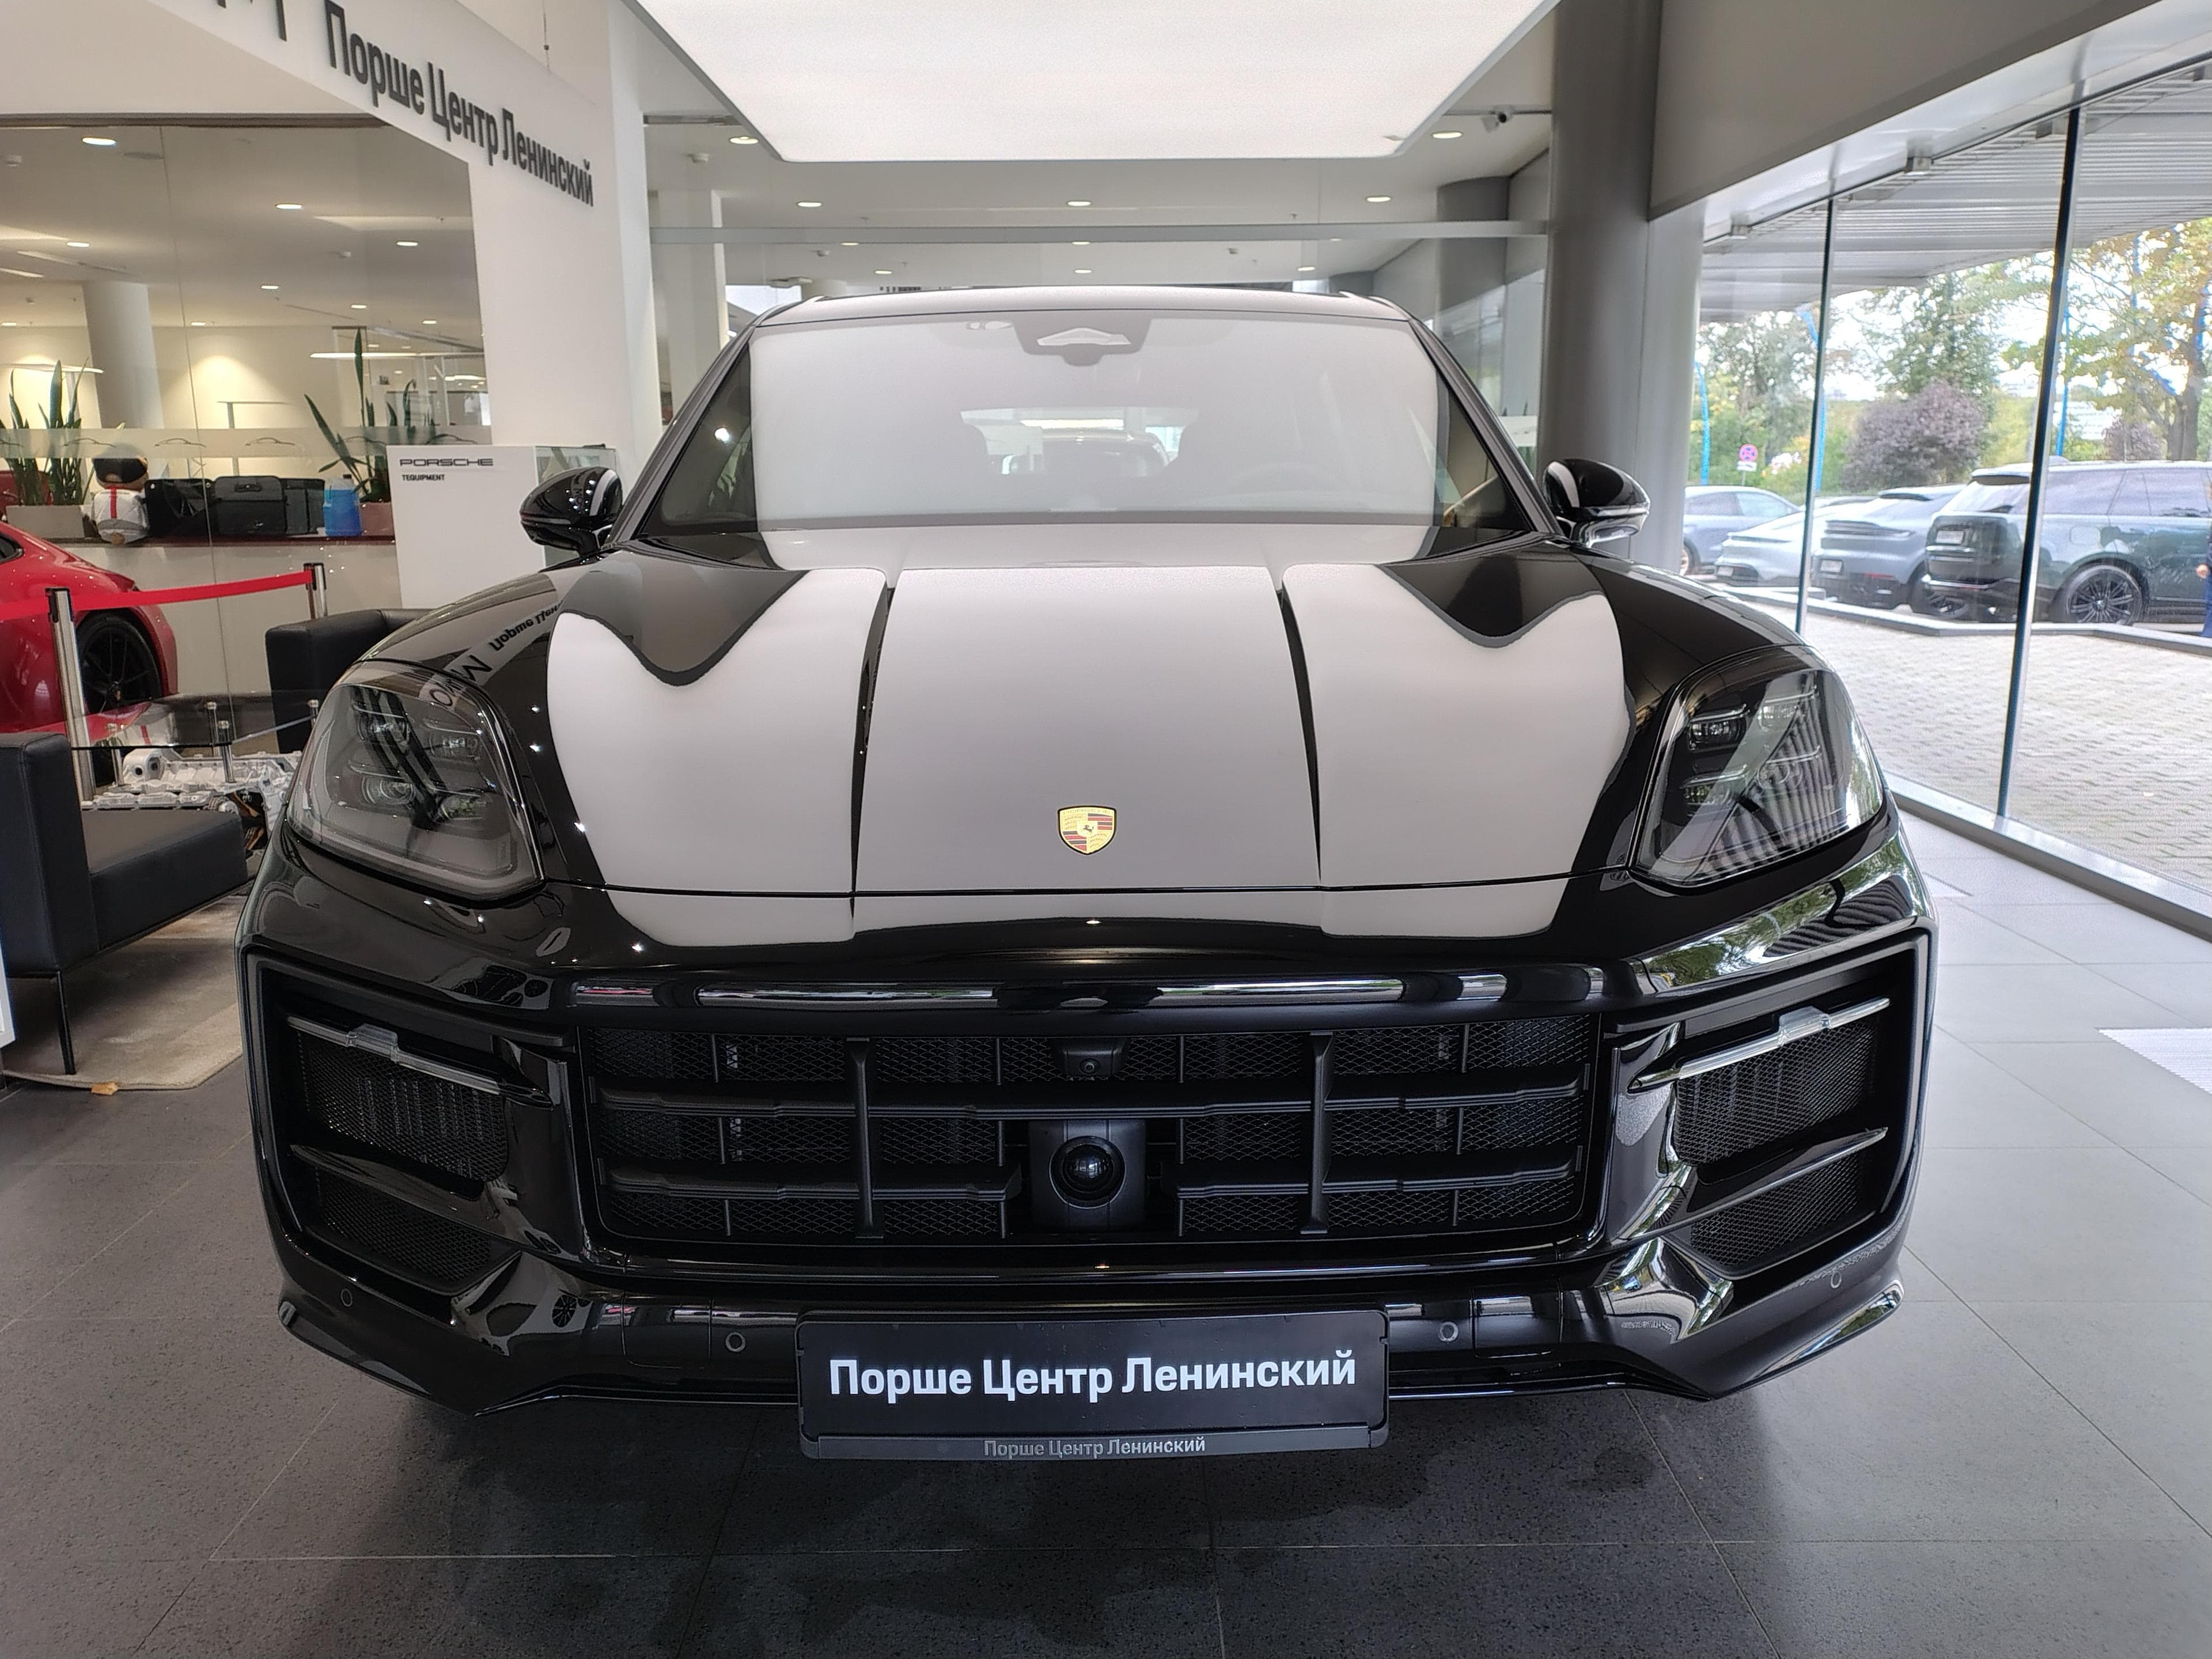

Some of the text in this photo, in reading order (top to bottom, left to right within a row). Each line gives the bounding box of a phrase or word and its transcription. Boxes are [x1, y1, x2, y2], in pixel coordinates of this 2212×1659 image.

[324, 0, 425, 115] Порше
[428, 62, 498, 166] Центр
[501, 108, 594, 207] Ленинский
[399, 458, 494, 467] PORSCHE
[830, 1349, 1356, 1404] Порше Центр Ленинский
[984, 1437, 1206, 1460] Порше Центр Ленинский
